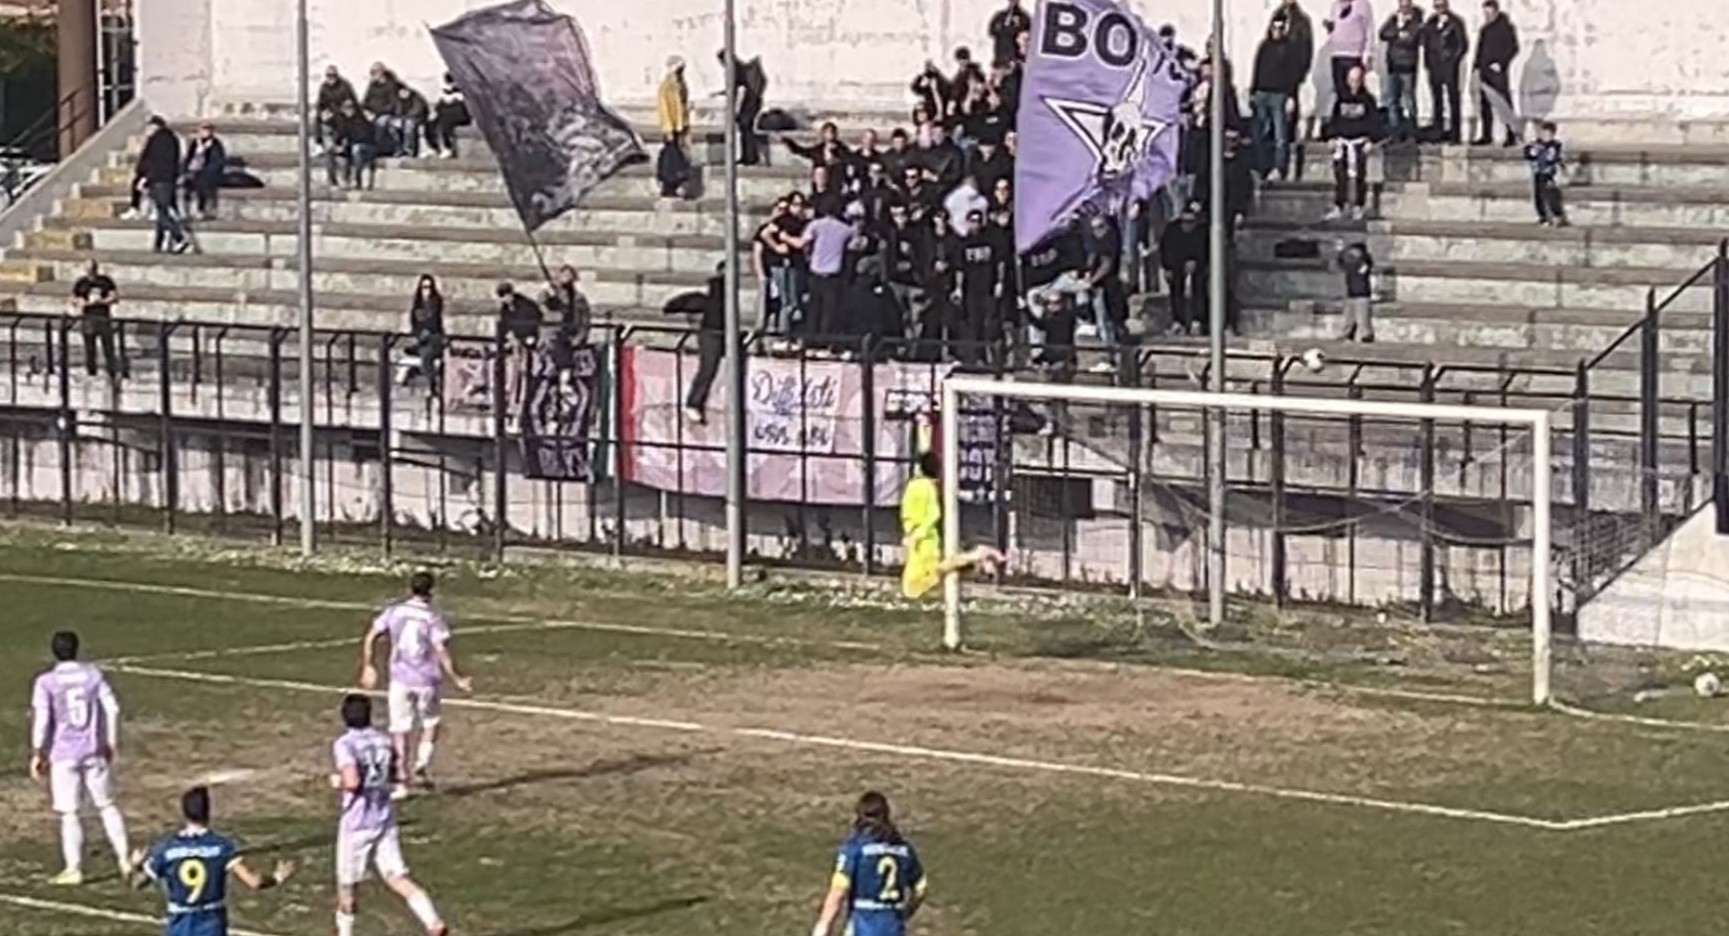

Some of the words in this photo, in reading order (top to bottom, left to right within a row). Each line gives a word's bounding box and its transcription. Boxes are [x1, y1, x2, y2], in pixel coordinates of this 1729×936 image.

[396, 618, 424, 653] 4
[179, 858, 206, 903] 9
[877, 855, 901, 900] 2
